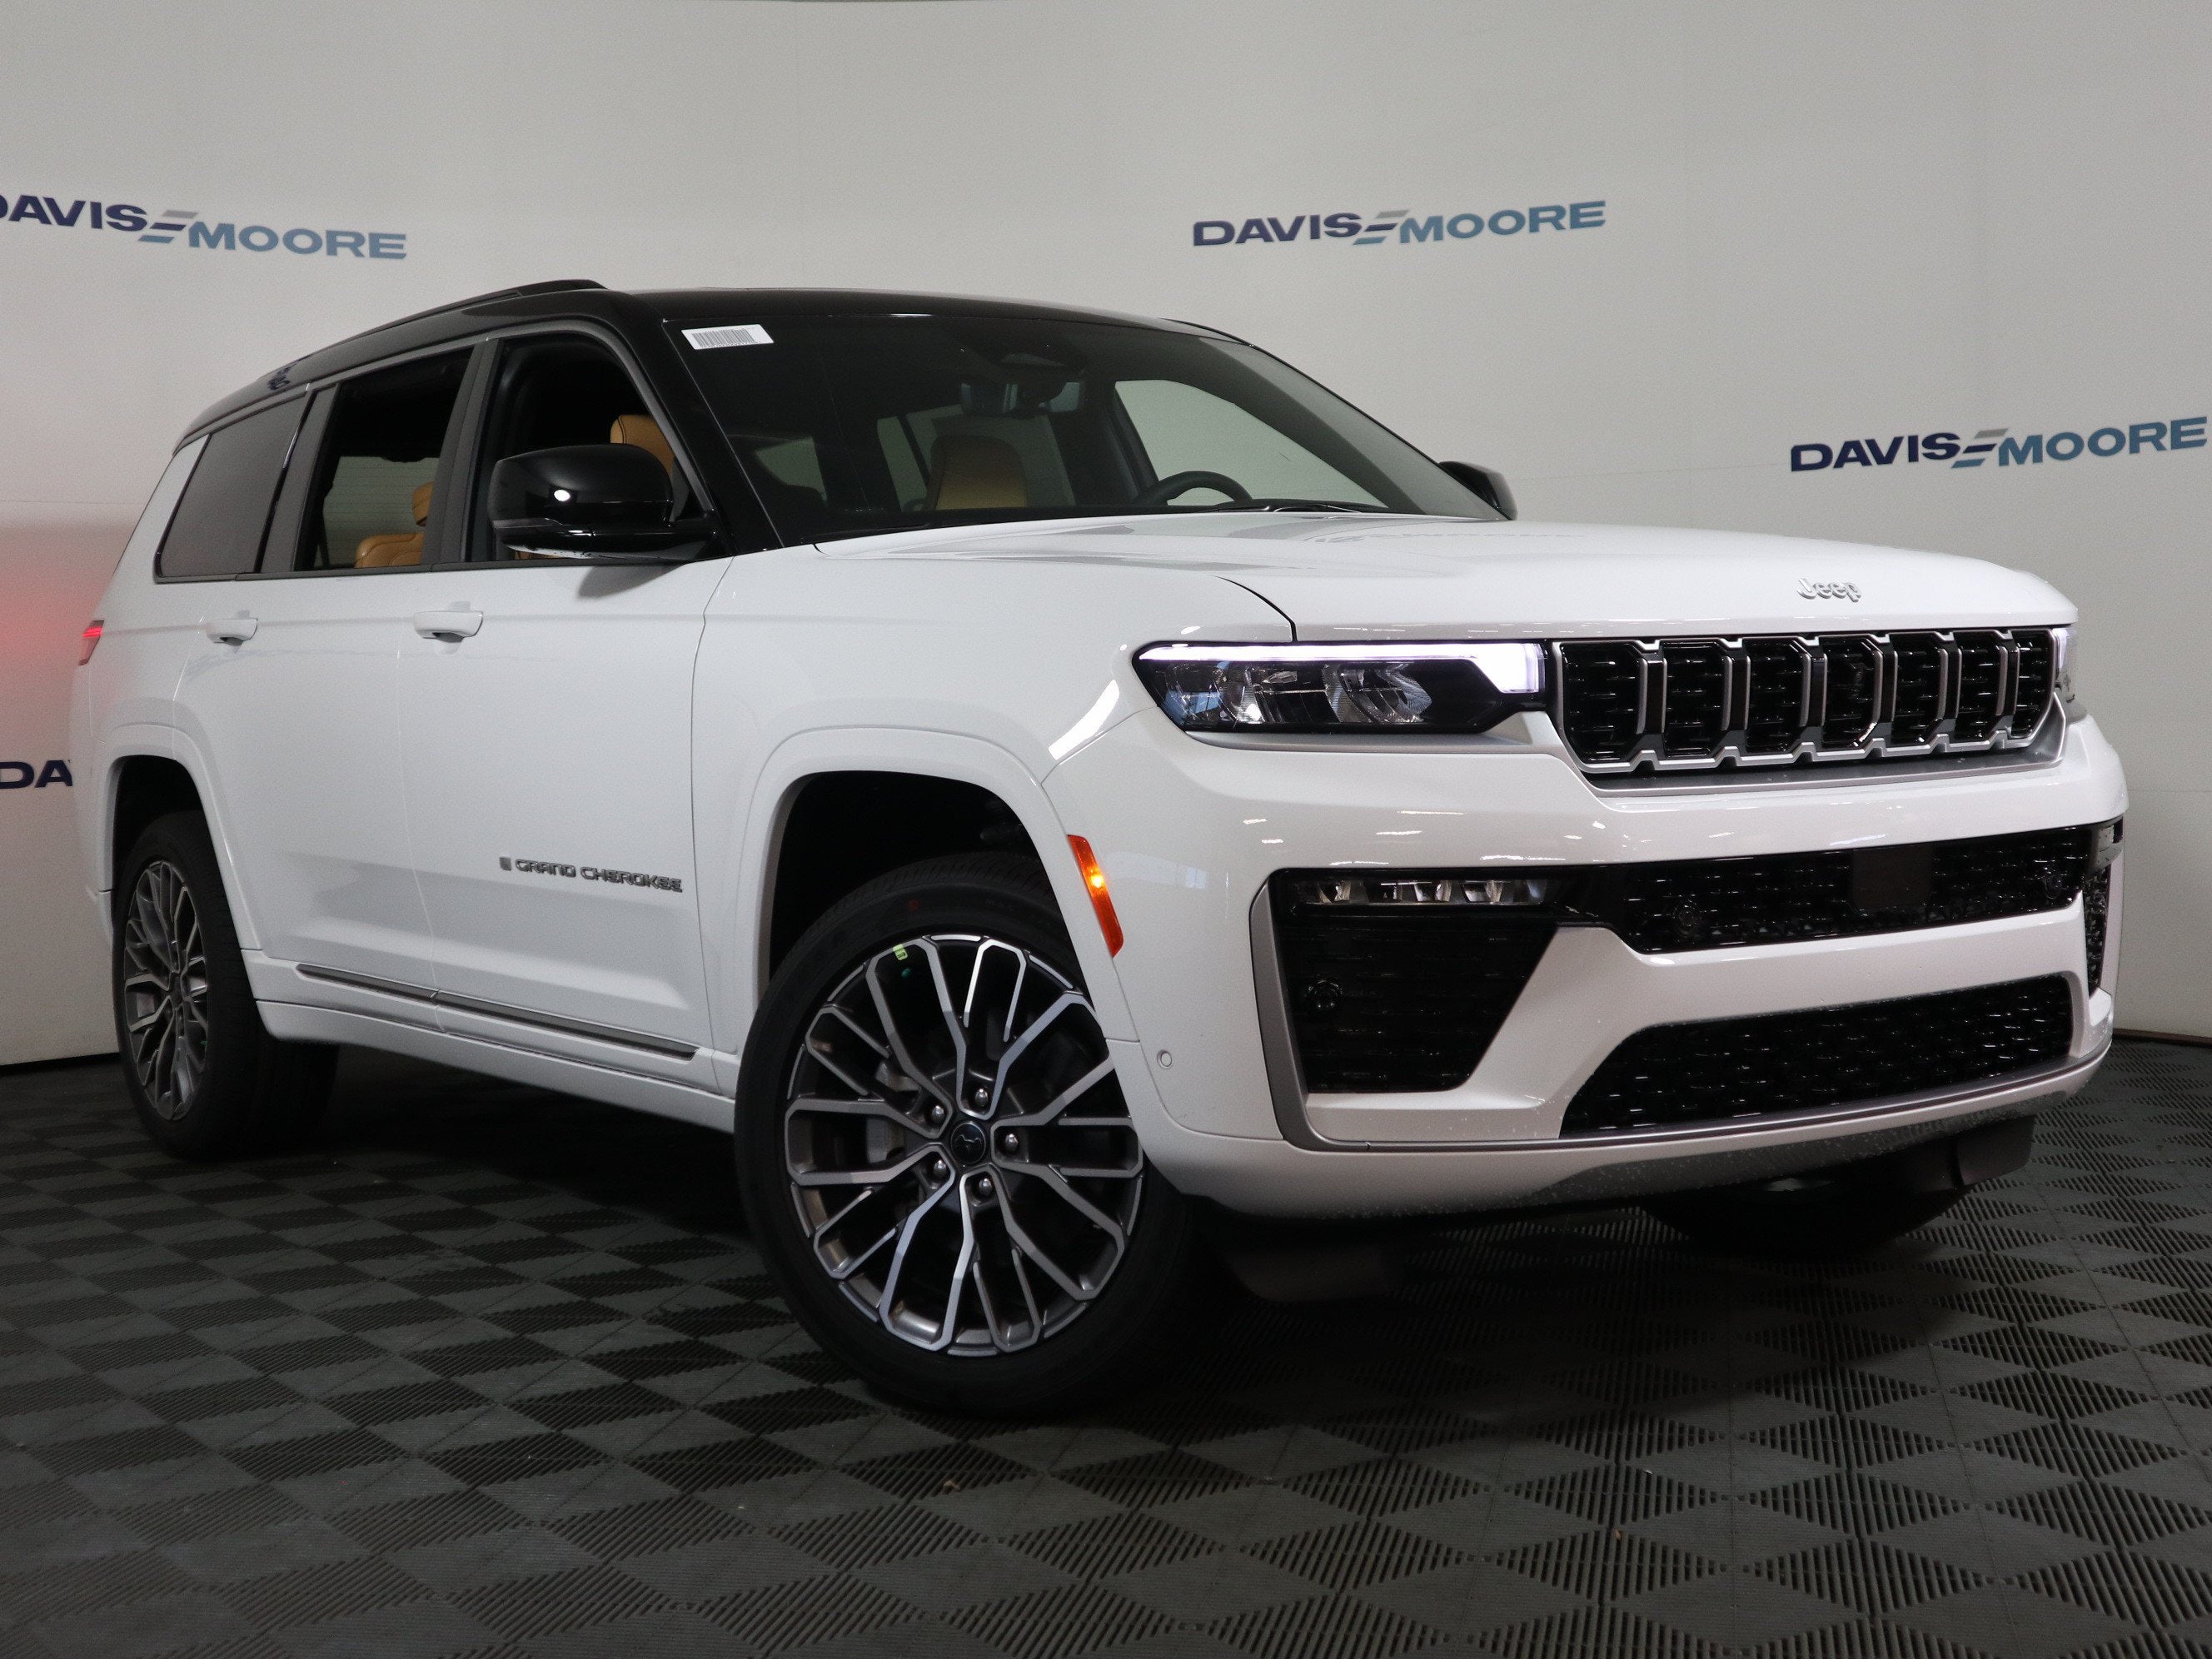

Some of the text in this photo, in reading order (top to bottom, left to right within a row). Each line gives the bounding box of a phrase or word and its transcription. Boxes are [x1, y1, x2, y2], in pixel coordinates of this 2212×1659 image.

[0, 194, 407, 260] AVIS MOORE
[1193, 200, 1606, 247] DAVIS MOORE
[1791, 416, 2209, 472] DAVIS MOORE
[1796, 577, 1862, 603] Jeep
[0, 760, 73, 789] DA
[515, 859, 683, 893] GRAND CHEROKEE
